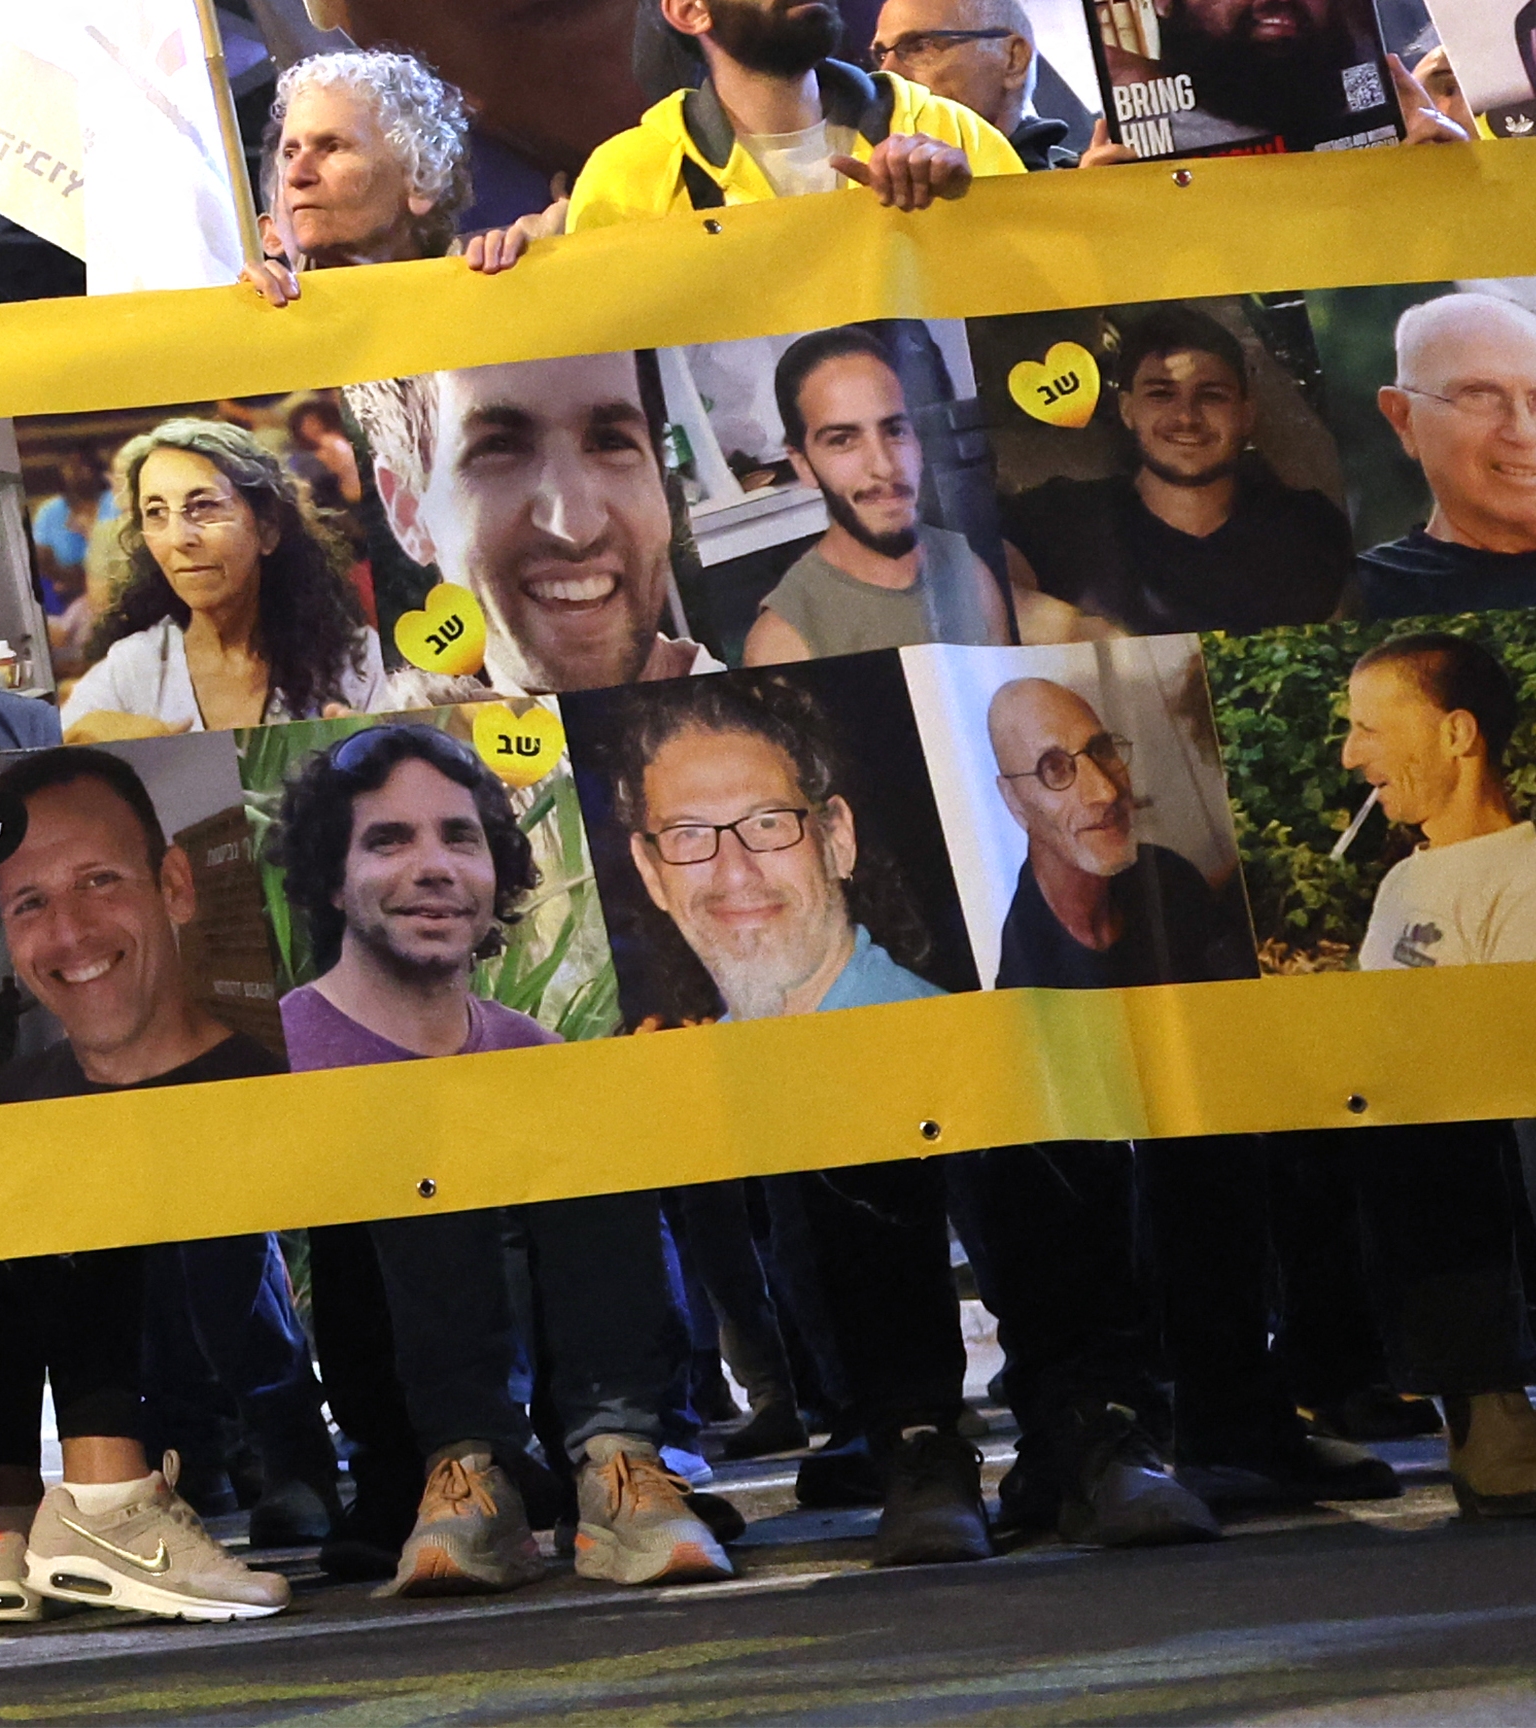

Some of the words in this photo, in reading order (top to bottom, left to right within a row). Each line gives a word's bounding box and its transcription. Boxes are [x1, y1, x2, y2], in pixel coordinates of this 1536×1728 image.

[1112, 73, 1196, 122] BRING
[1119, 117, 1175, 159] HIM
[1037, 370, 1081, 406] שב
[425, 614, 465, 656] שב
[497, 733, 542, 757] שב
